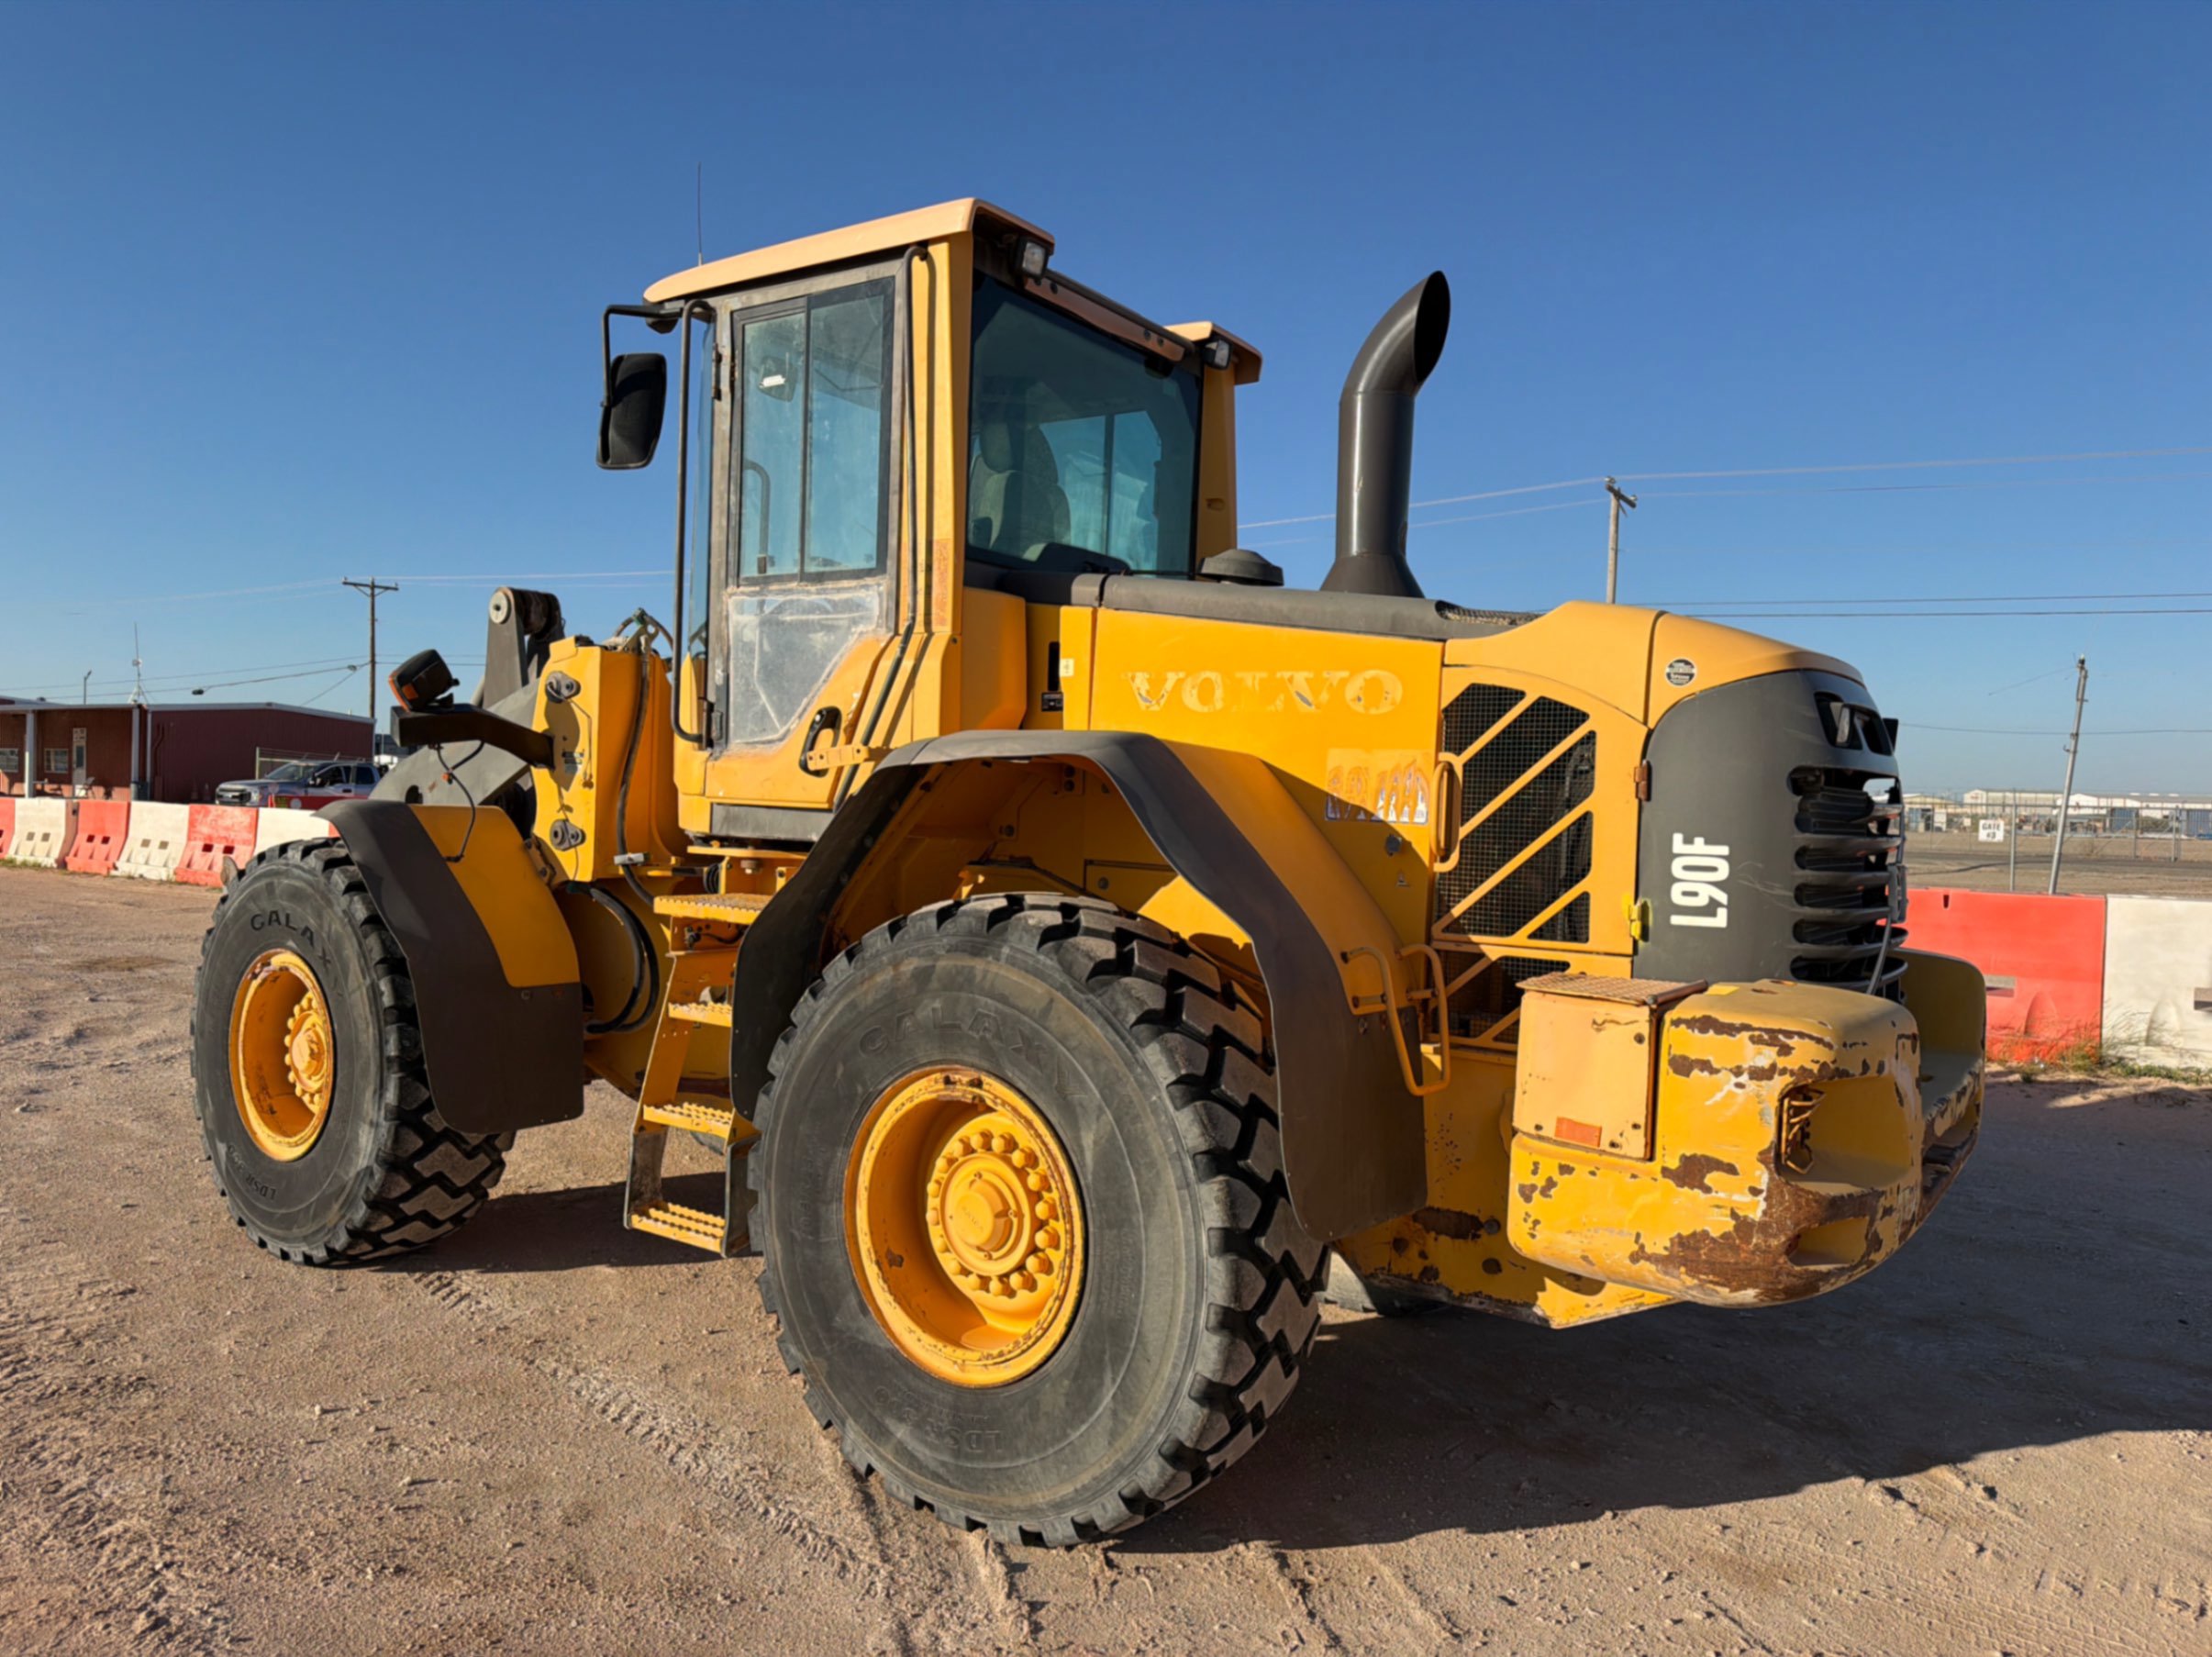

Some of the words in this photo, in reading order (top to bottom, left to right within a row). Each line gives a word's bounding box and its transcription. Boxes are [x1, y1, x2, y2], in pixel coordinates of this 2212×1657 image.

[1122, 670, 1404, 714] VOLVO
[1982, 822, 2001, 831] GATE
[1670, 832, 1729, 929] L90F
